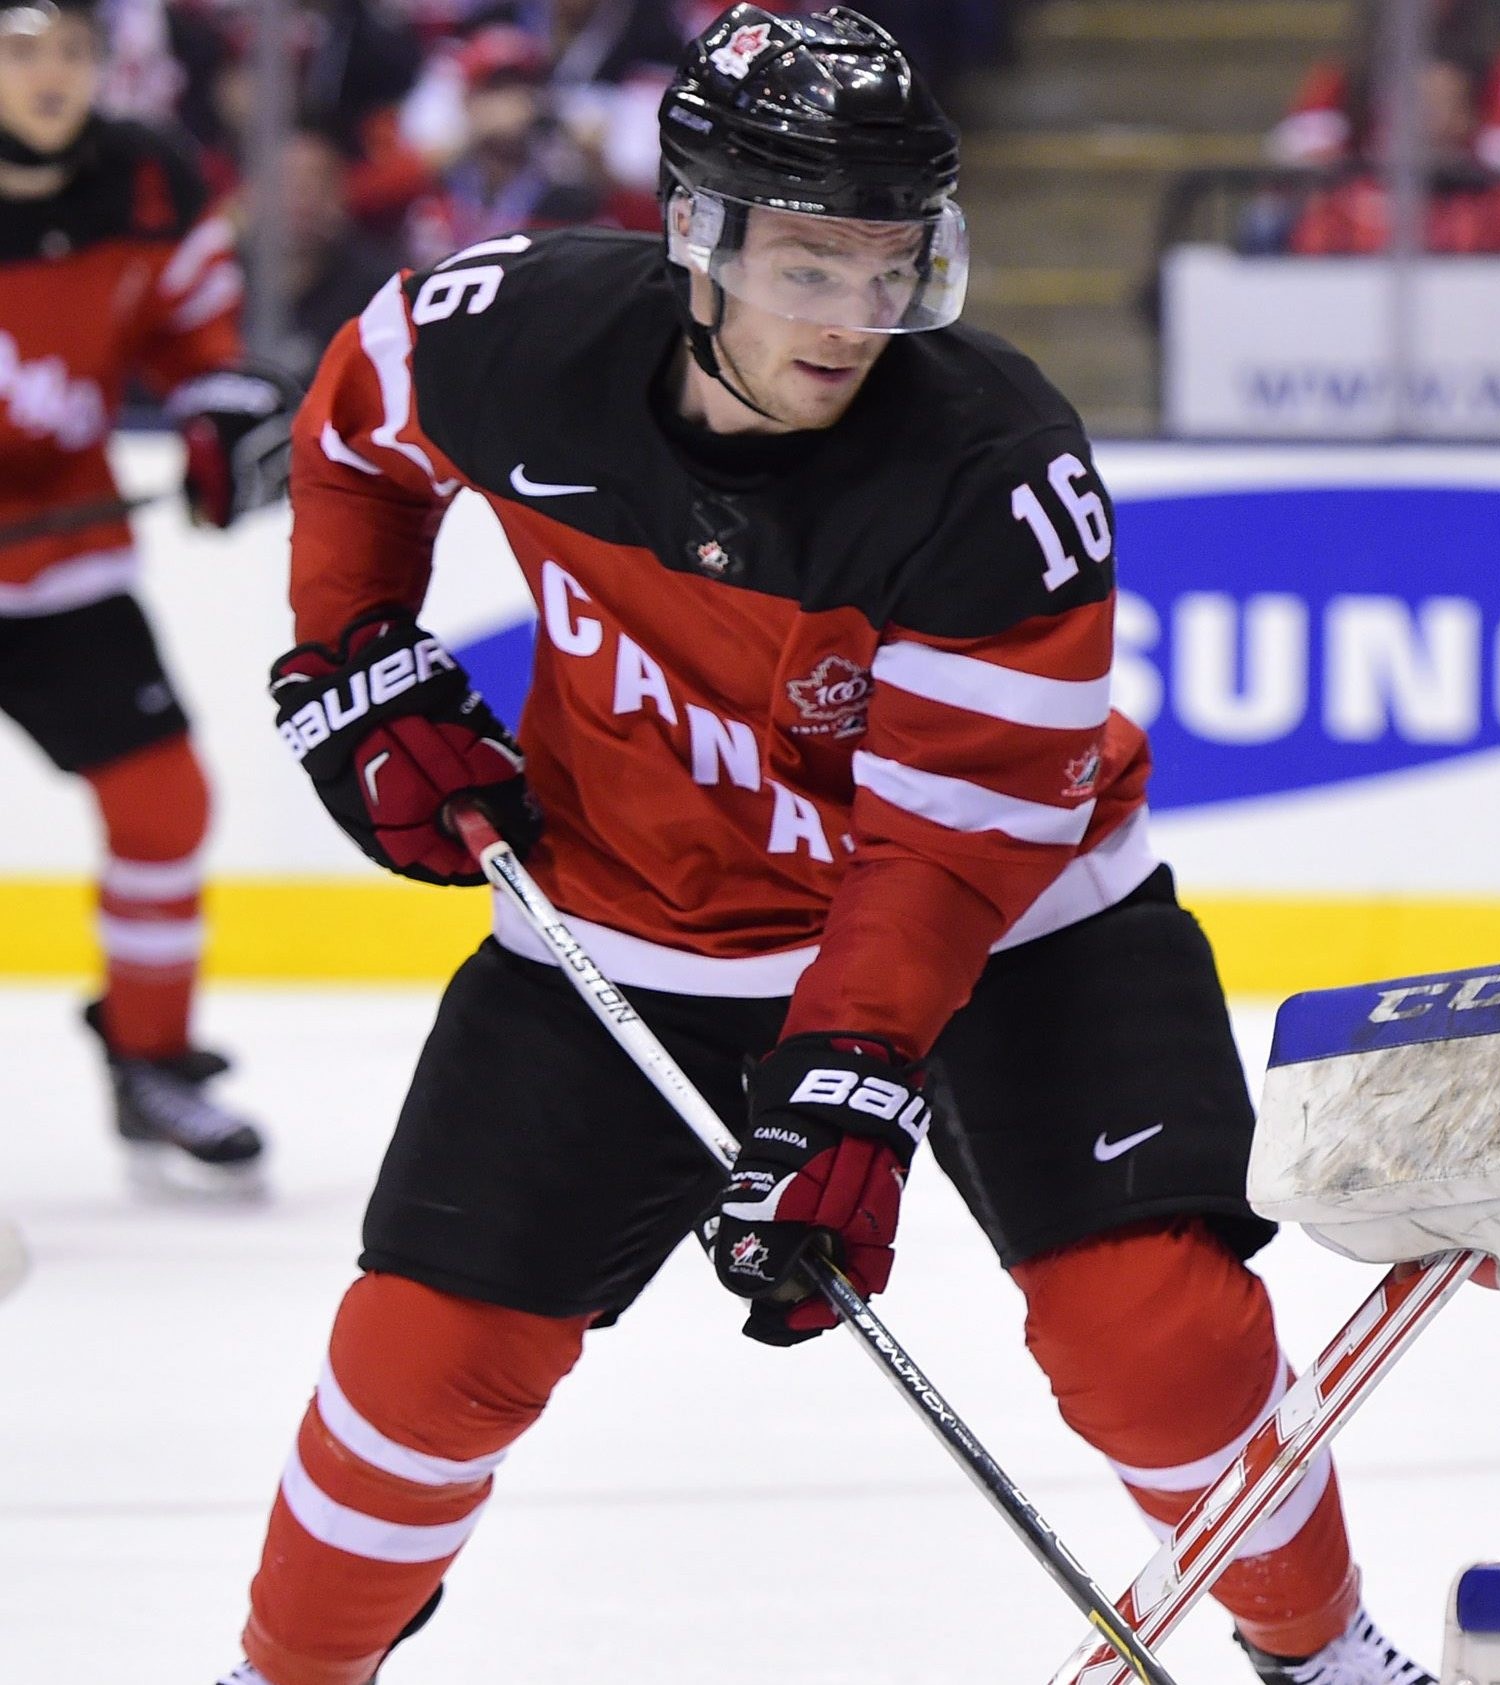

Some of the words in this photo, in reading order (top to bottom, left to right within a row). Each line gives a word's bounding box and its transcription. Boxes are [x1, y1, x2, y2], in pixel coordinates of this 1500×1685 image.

[411, 234, 532, 326] 16
[1011, 452, 1112, 592] 16
[543, 560, 855, 863] CANA
[545, 923, 639, 1024] EASTON
[754, 1126, 808, 1149] CANADA
